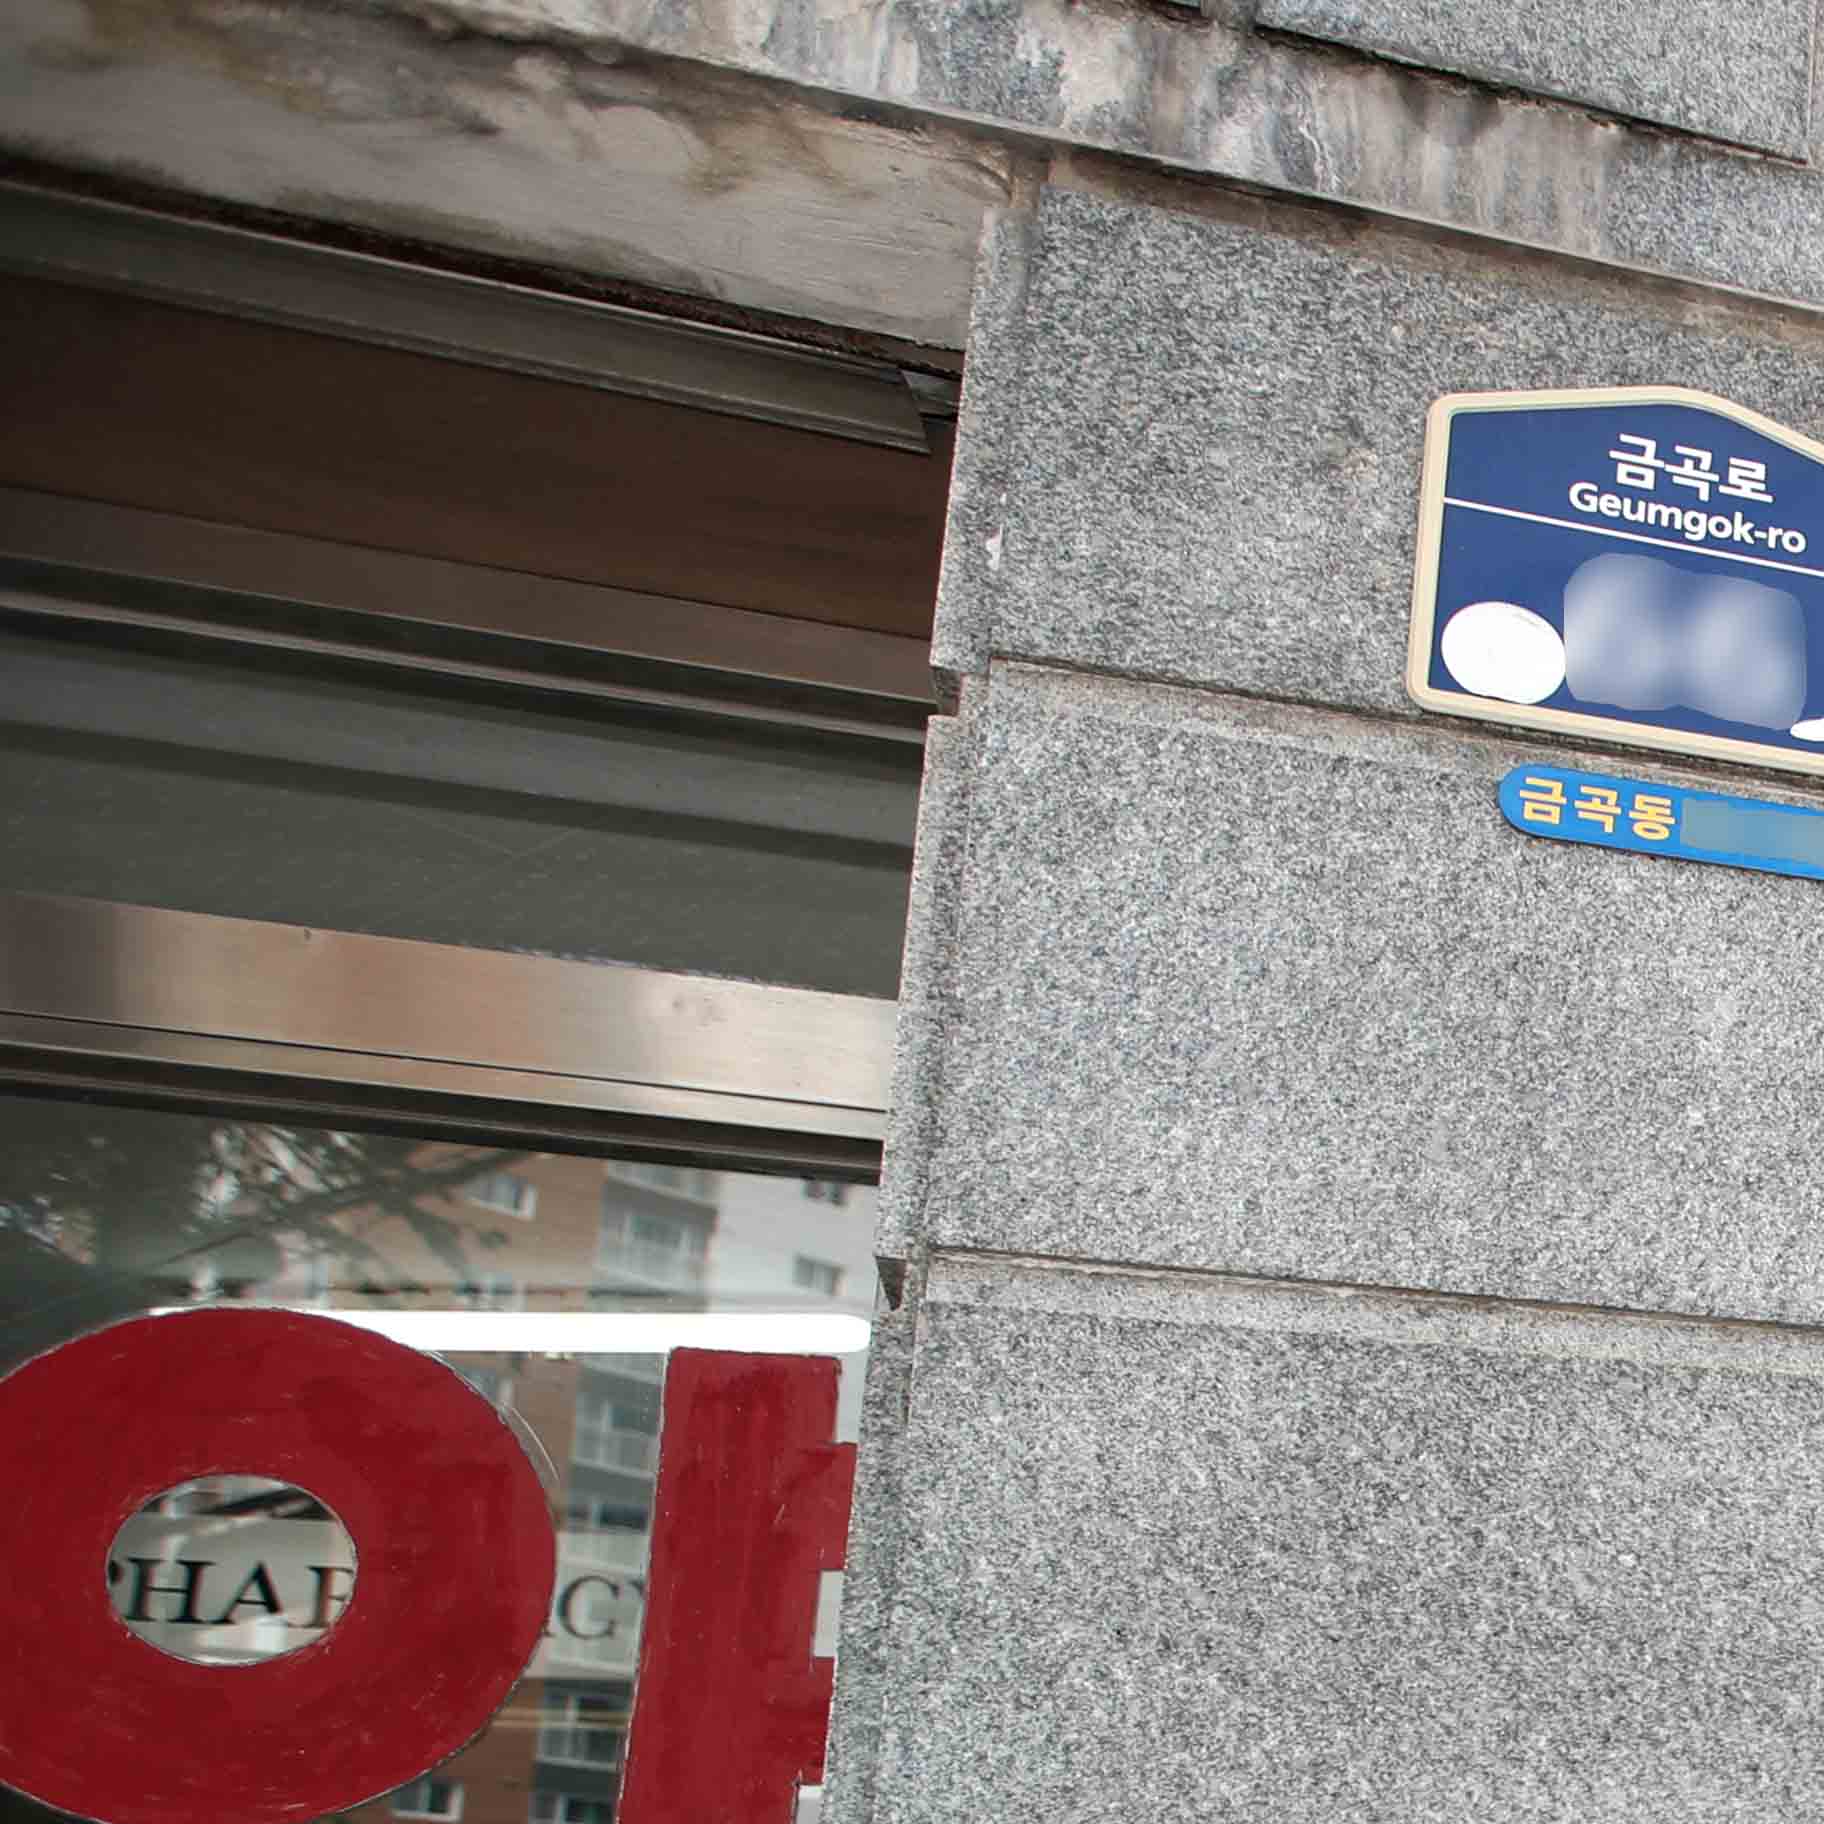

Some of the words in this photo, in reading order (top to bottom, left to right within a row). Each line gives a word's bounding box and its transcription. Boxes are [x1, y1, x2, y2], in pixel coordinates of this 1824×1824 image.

[1609, 433, 1774, 503] 금곡로
[1568, 481, 1807, 554] Geumgok-ro
[1519, 776, 1676, 841] 금곡동
